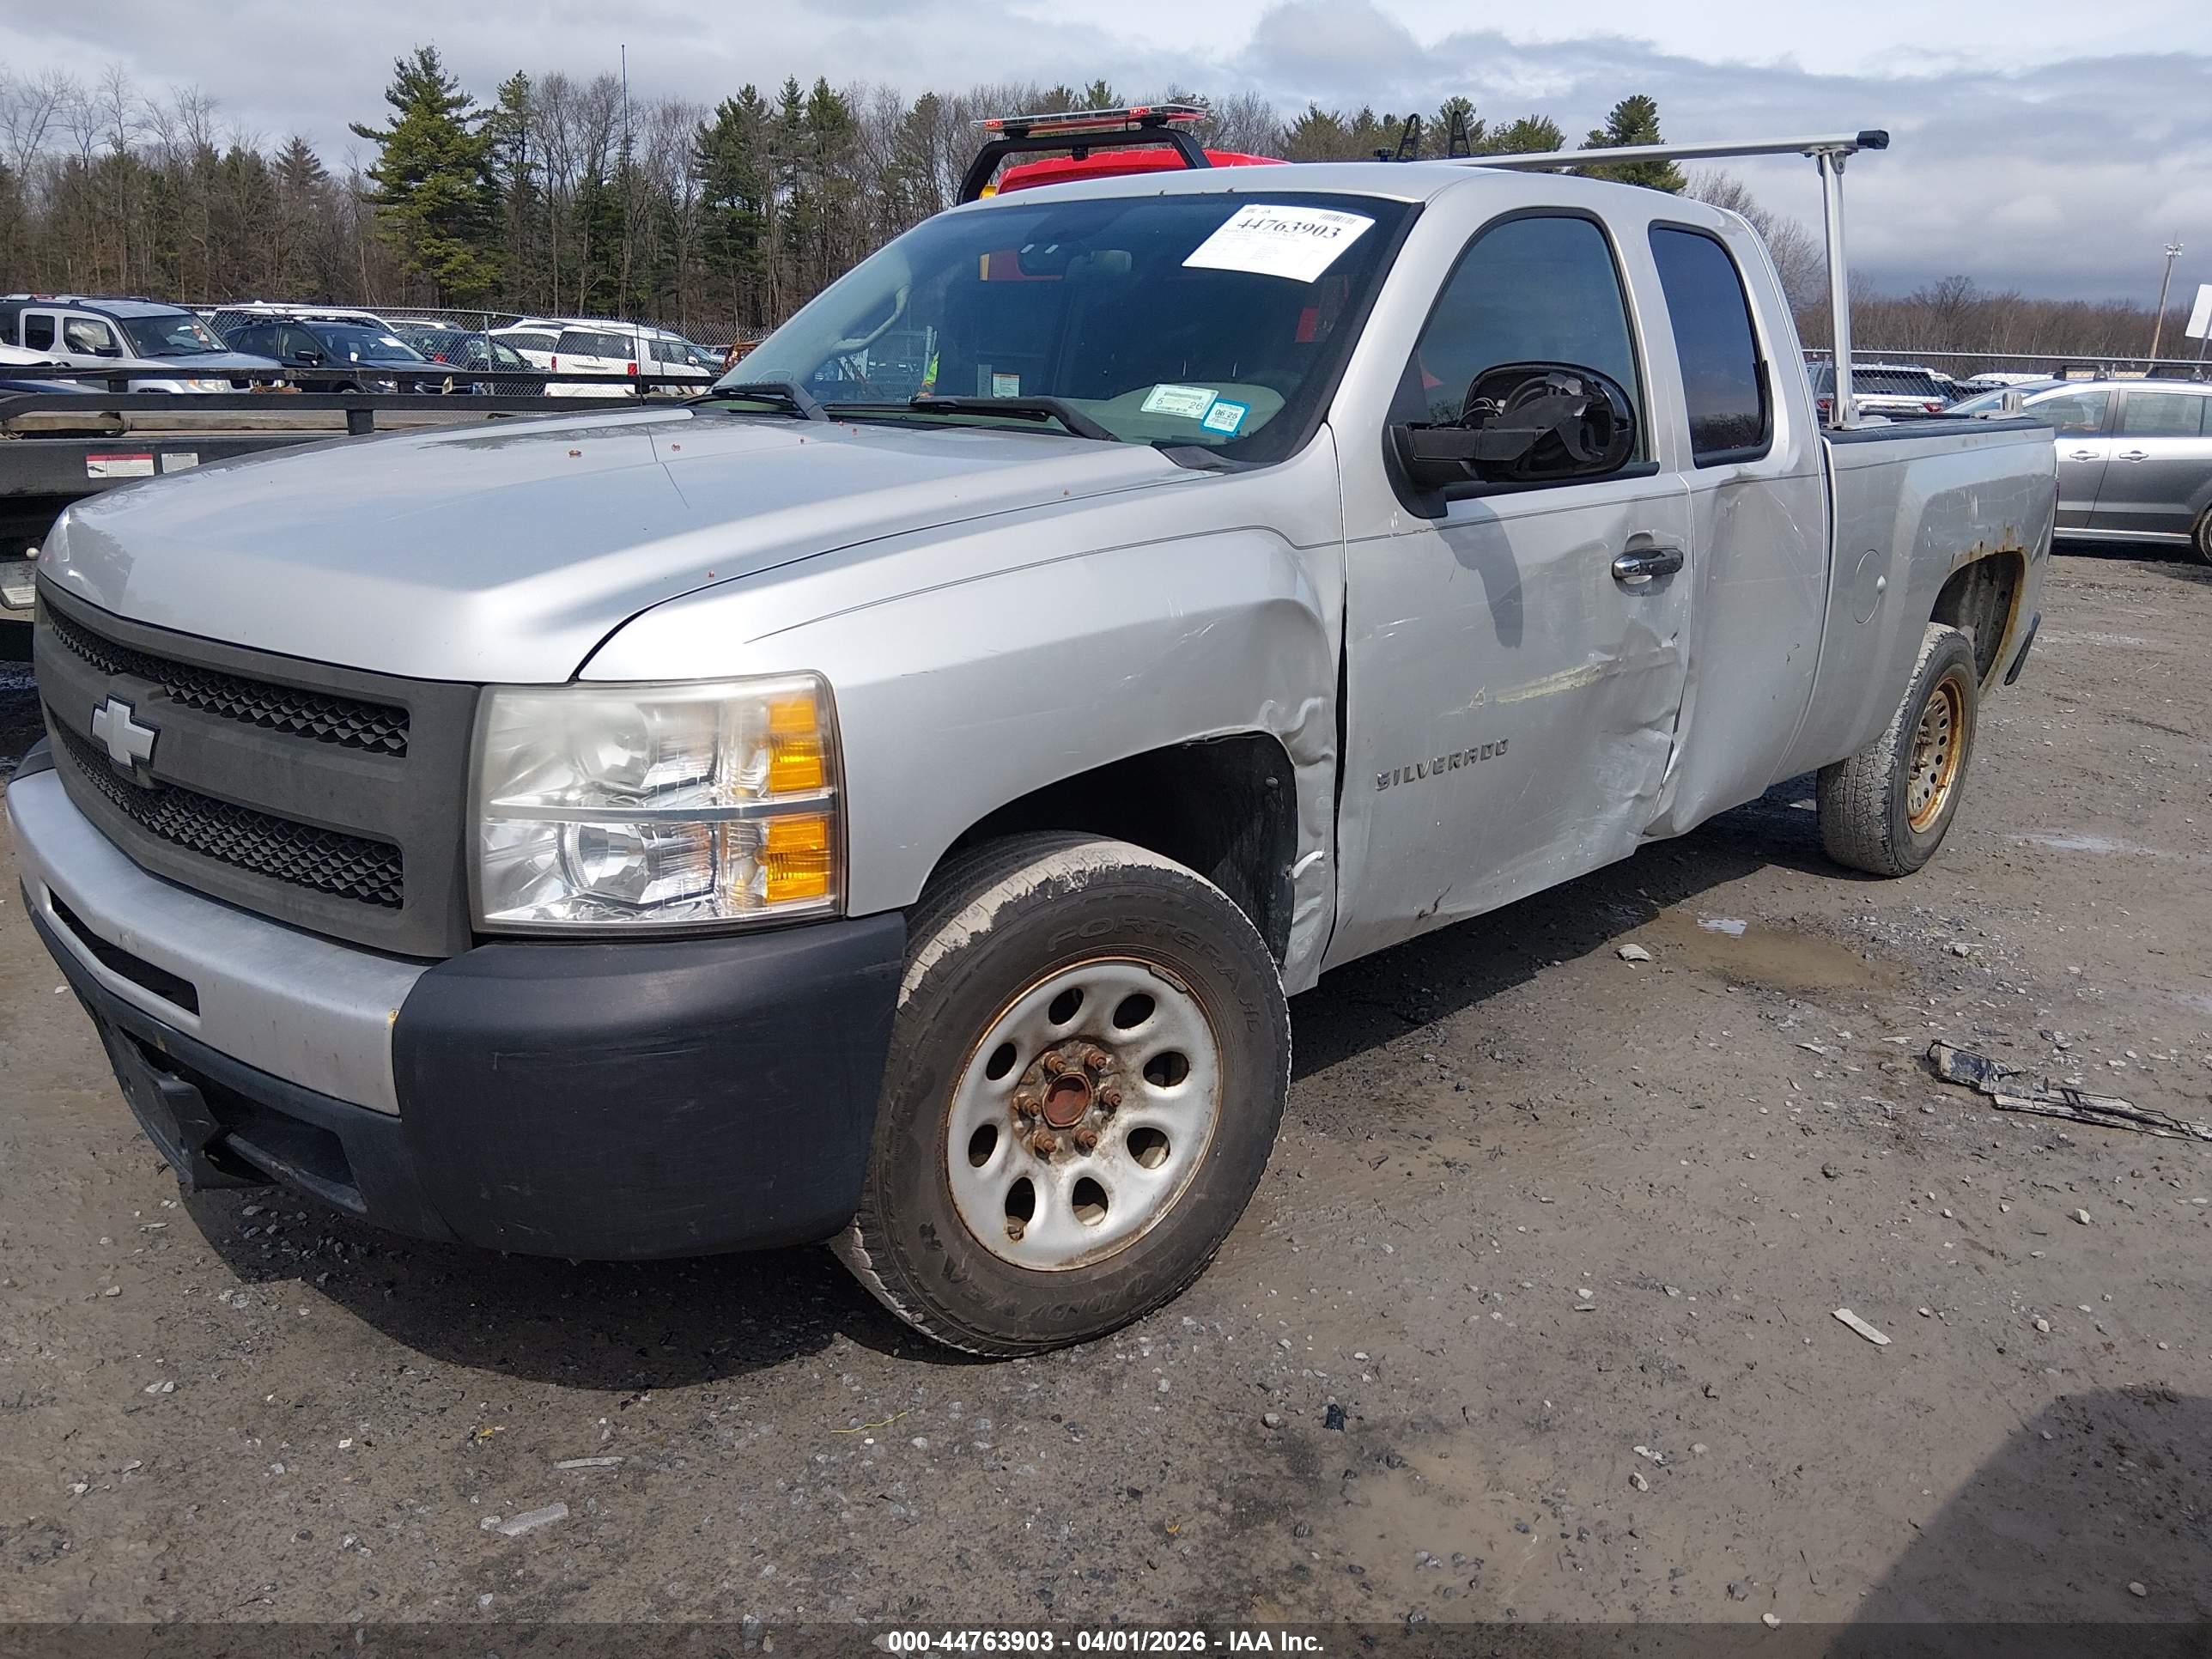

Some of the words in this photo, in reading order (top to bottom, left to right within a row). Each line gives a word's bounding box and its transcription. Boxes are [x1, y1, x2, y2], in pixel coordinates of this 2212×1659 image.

[1237, 218, 1341, 239] 44763903
[1188, 400, 1204, 410] 26
[1374, 738, 1509, 792] SILVERADO
[1048, 915, 1243, 994] FORTERA
